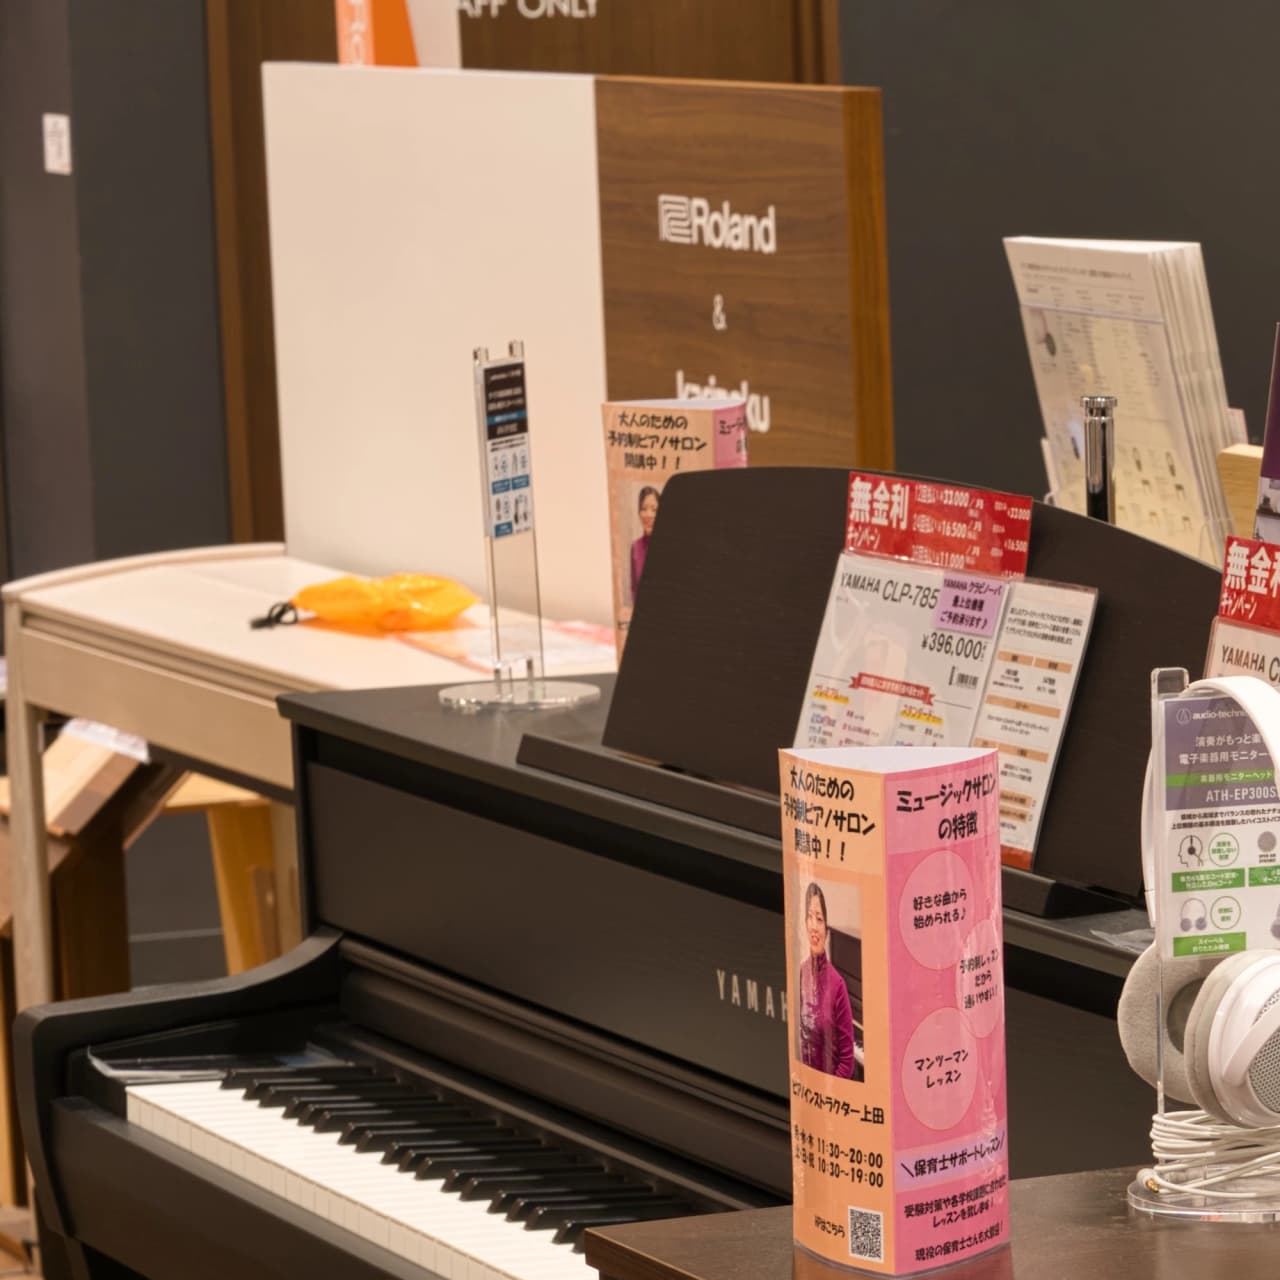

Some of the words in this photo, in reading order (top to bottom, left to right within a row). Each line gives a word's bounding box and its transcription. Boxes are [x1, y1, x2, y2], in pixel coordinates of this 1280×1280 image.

[690, 198, 776, 253] Roland
[713, 294, 727, 330] &
[618, 410, 688, 430] 大人のための
[850, 477, 910, 530] 無金利
[840, 573, 881, 594] YAMAHA
[882, 579, 940, 610] CLP-785
[1221, 592, 1257, 620] キャンペーン
[921, 632, 983, 660] ¥396,000
[1222, 645, 1265, 673] YAMAHA
[790, 765, 854, 801] 大人のための
[896, 775, 997, 813] ミュージックサロン
[1206, 786, 1280, 803] ATH-EP300S
[784, 792, 876, 836] 予約制ピアノサロン
[938, 810, 978, 841] の特徴
[913, 888, 968, 912] 好きな曲から
[716, 968, 788, 1022] YAMAH
[914, 1049, 969, 1072] マンツーマン
[926, 1069, 962, 1089] レッスン
